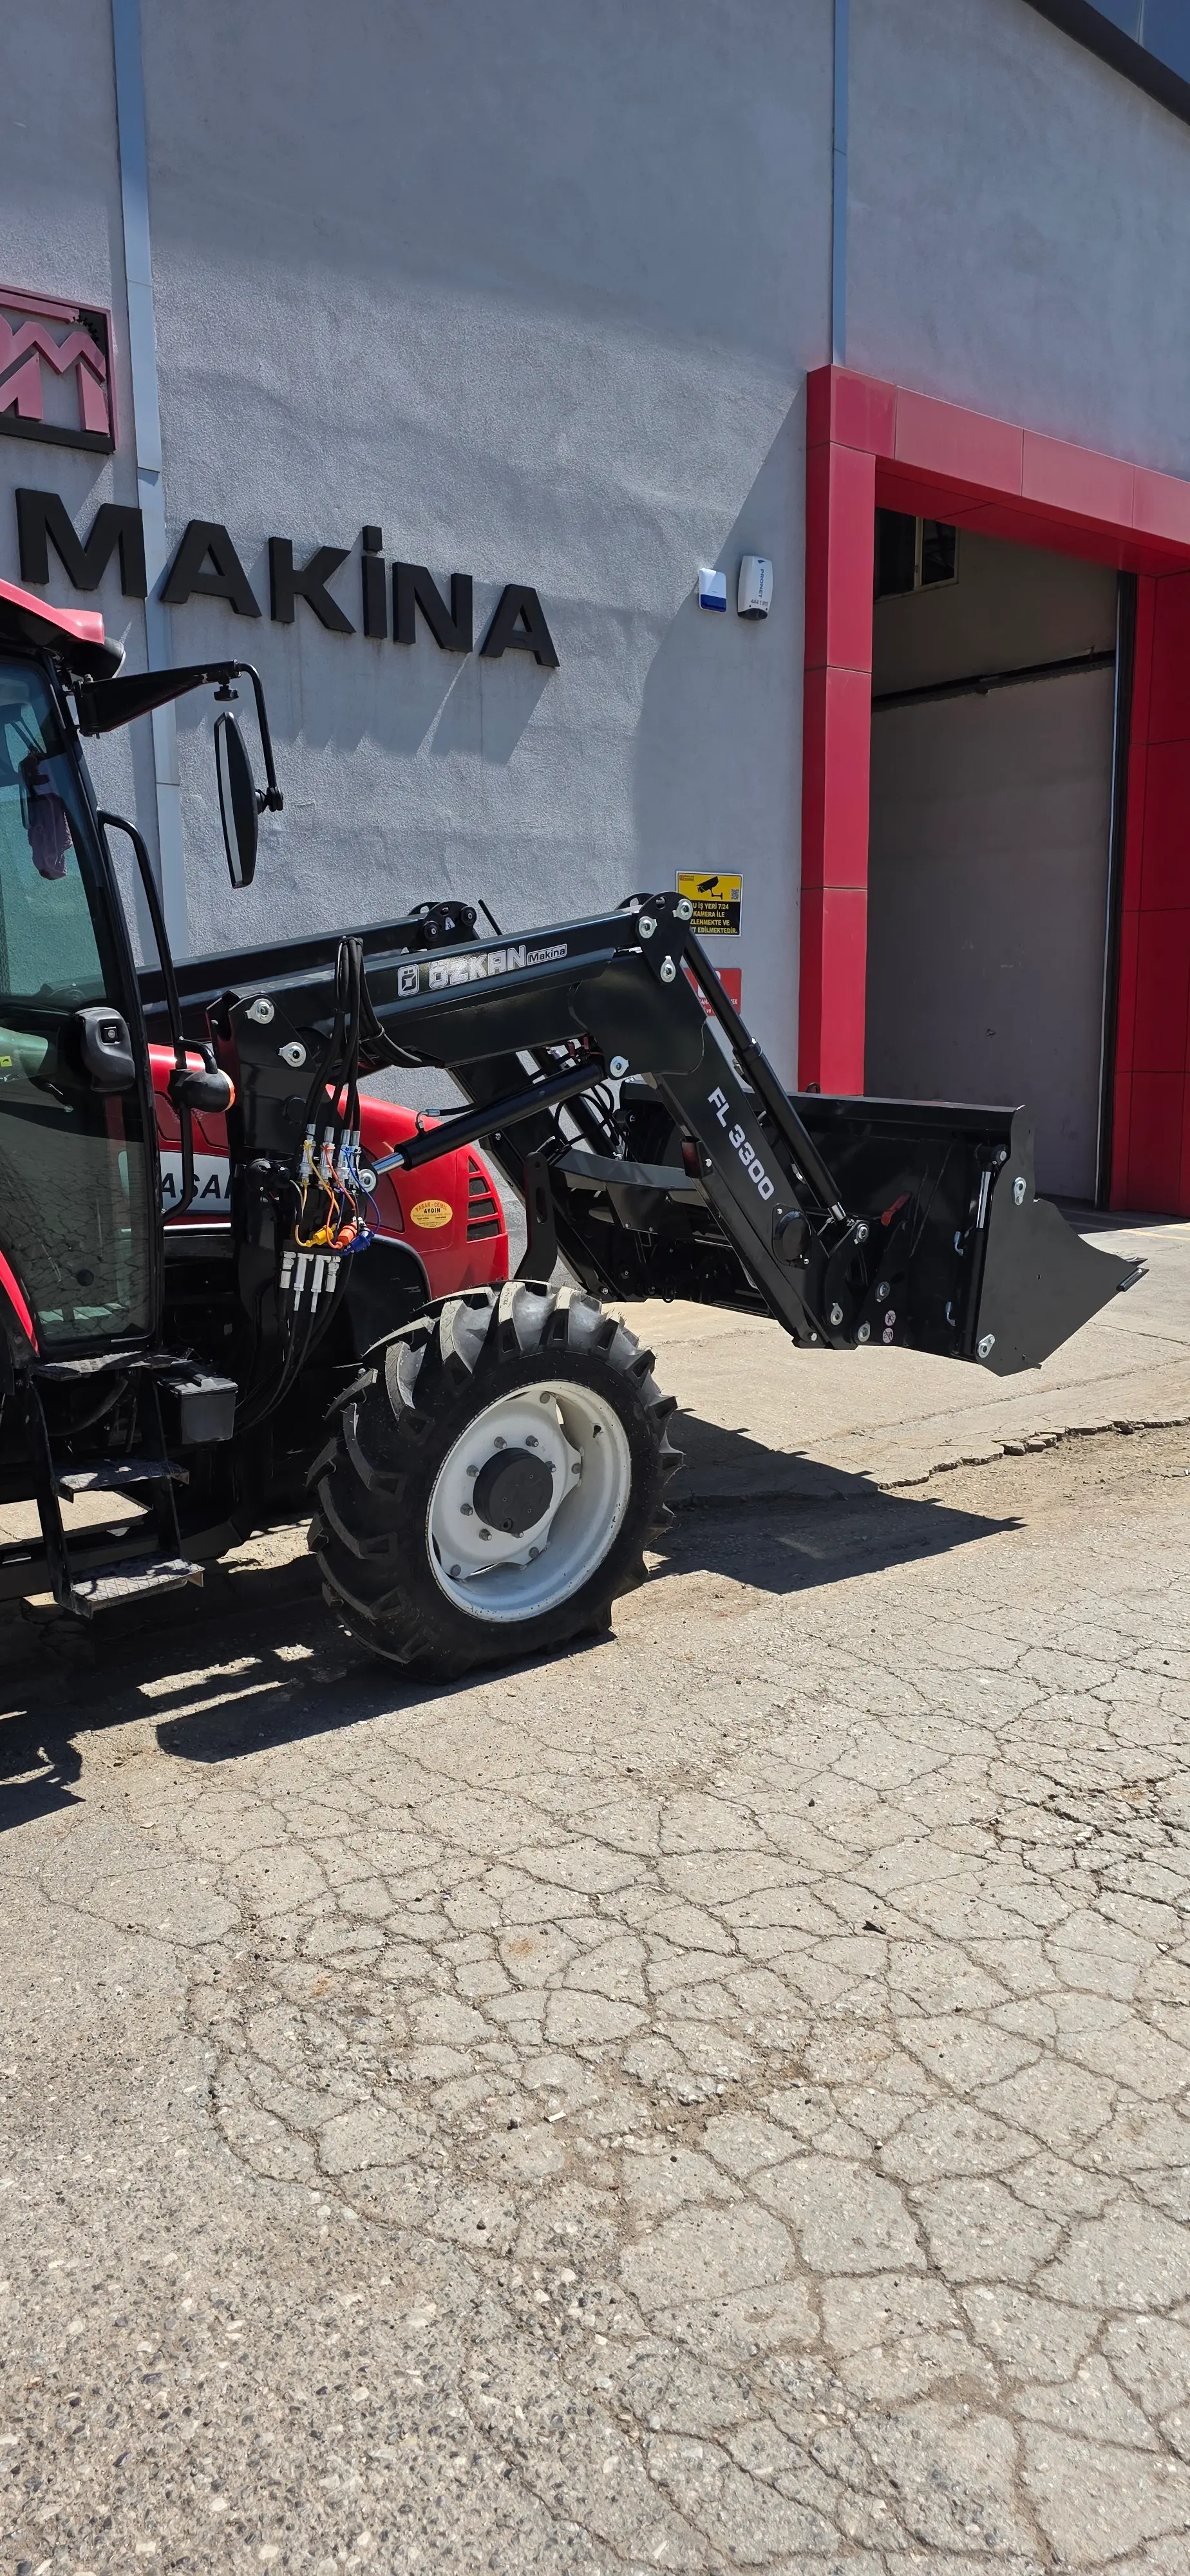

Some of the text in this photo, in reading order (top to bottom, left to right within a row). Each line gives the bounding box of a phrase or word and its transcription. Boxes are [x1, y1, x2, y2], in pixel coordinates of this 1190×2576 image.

[15, 488, 561, 668] MAKİNA
[698, 902, 704, 910] İŞ
[428, 945, 526, 989] ÖZKAN
[528, 947, 566, 963] Makina
[707, 1086, 775, 1200] FL 3300
